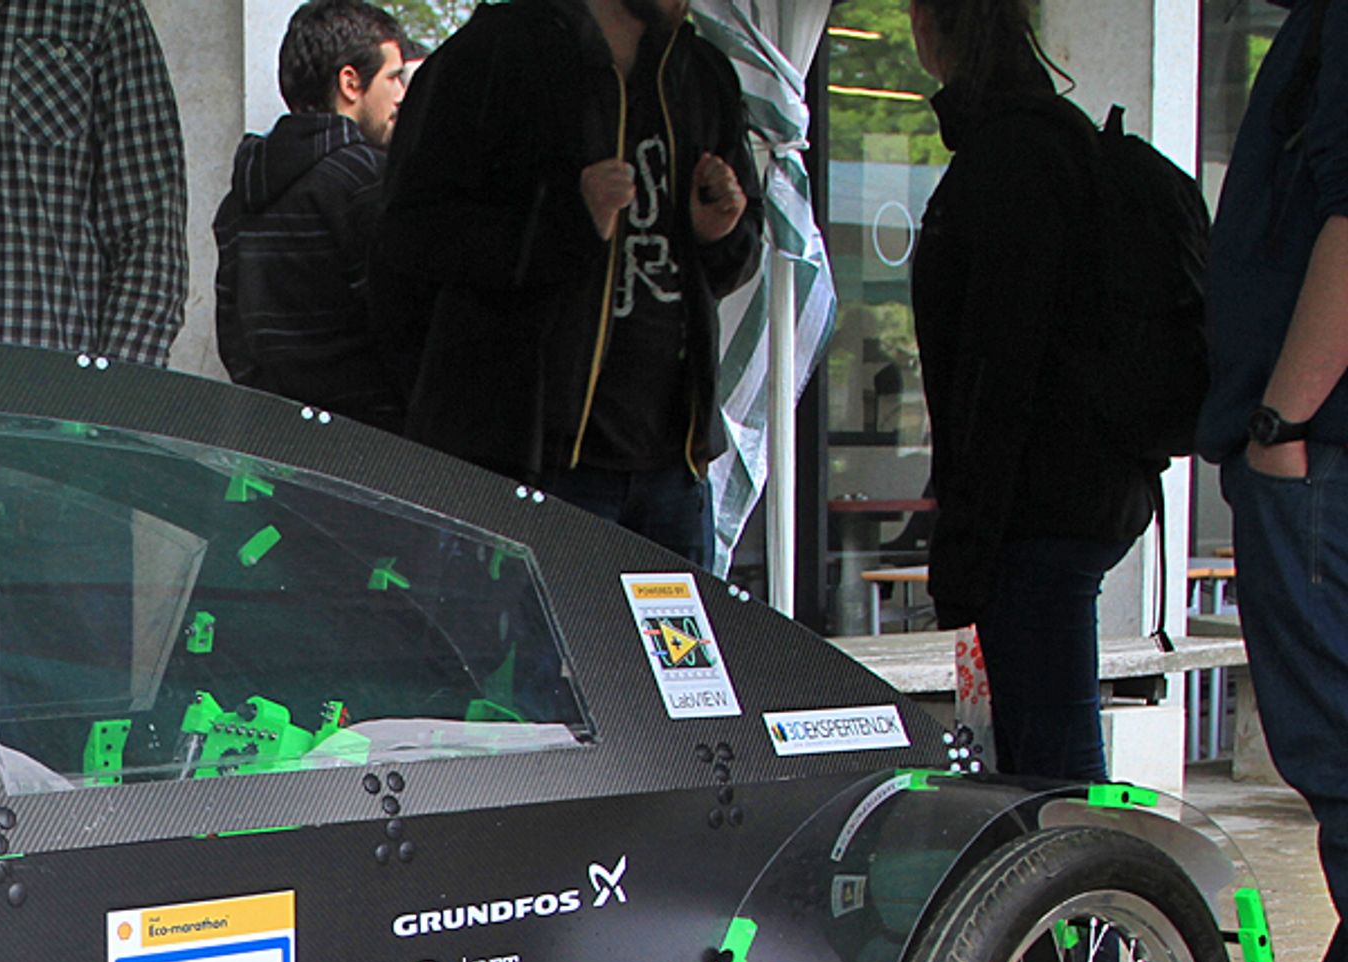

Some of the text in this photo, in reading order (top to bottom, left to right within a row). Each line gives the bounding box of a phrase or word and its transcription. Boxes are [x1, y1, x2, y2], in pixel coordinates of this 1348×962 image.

[669, 690, 728, 709] LabVIEW
[393, 889, 581, 936] GRUNDFOS
[149, 917, 229, 938] Eco-marathon
